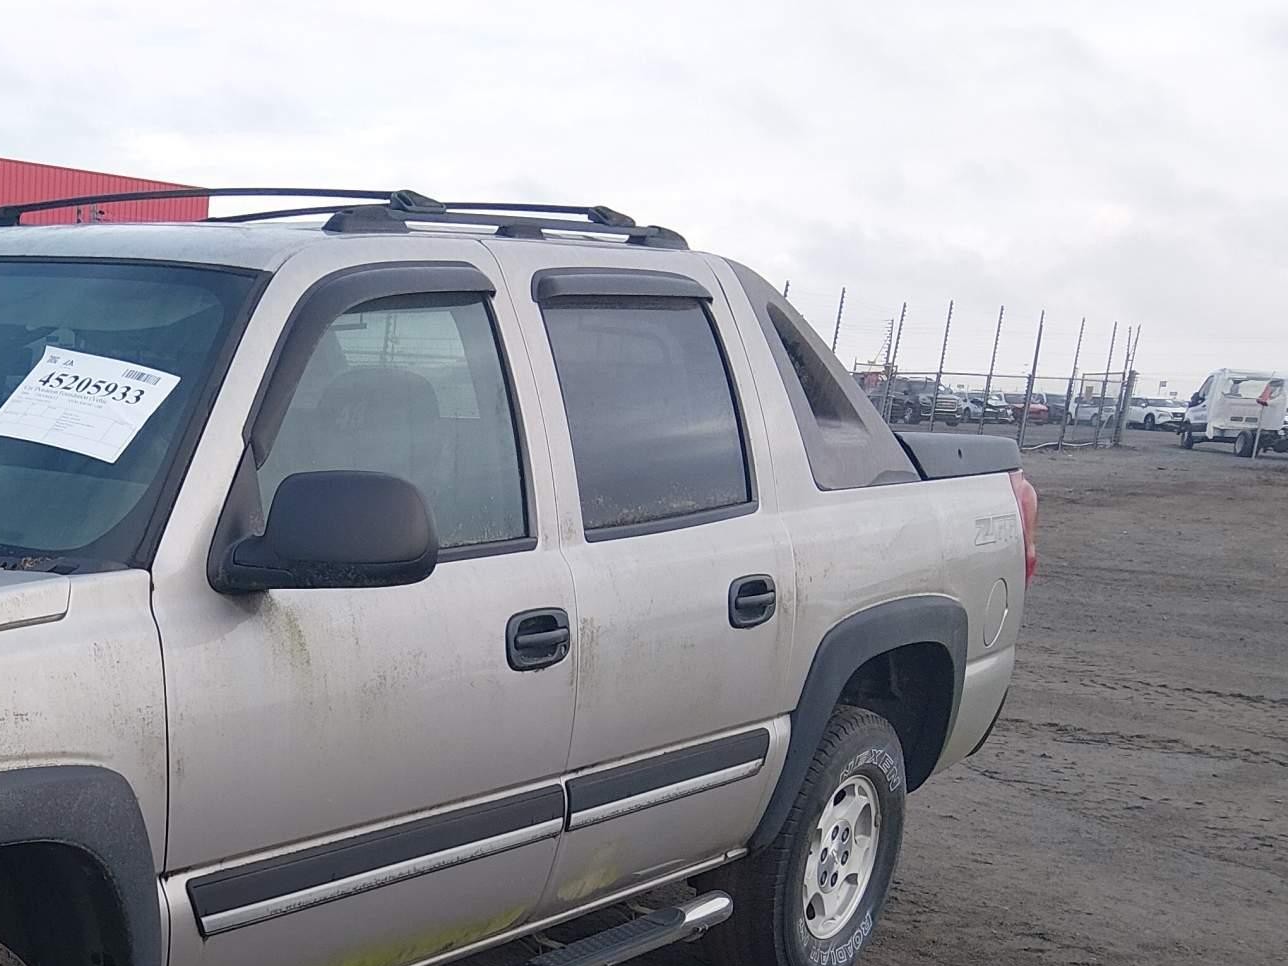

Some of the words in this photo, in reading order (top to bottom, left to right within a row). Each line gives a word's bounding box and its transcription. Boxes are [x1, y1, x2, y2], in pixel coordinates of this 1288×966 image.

[38, 371, 145, 406] 45205933
[839, 749, 901, 792] NEXEN
[810, 912, 873, 966] ROADIAN
